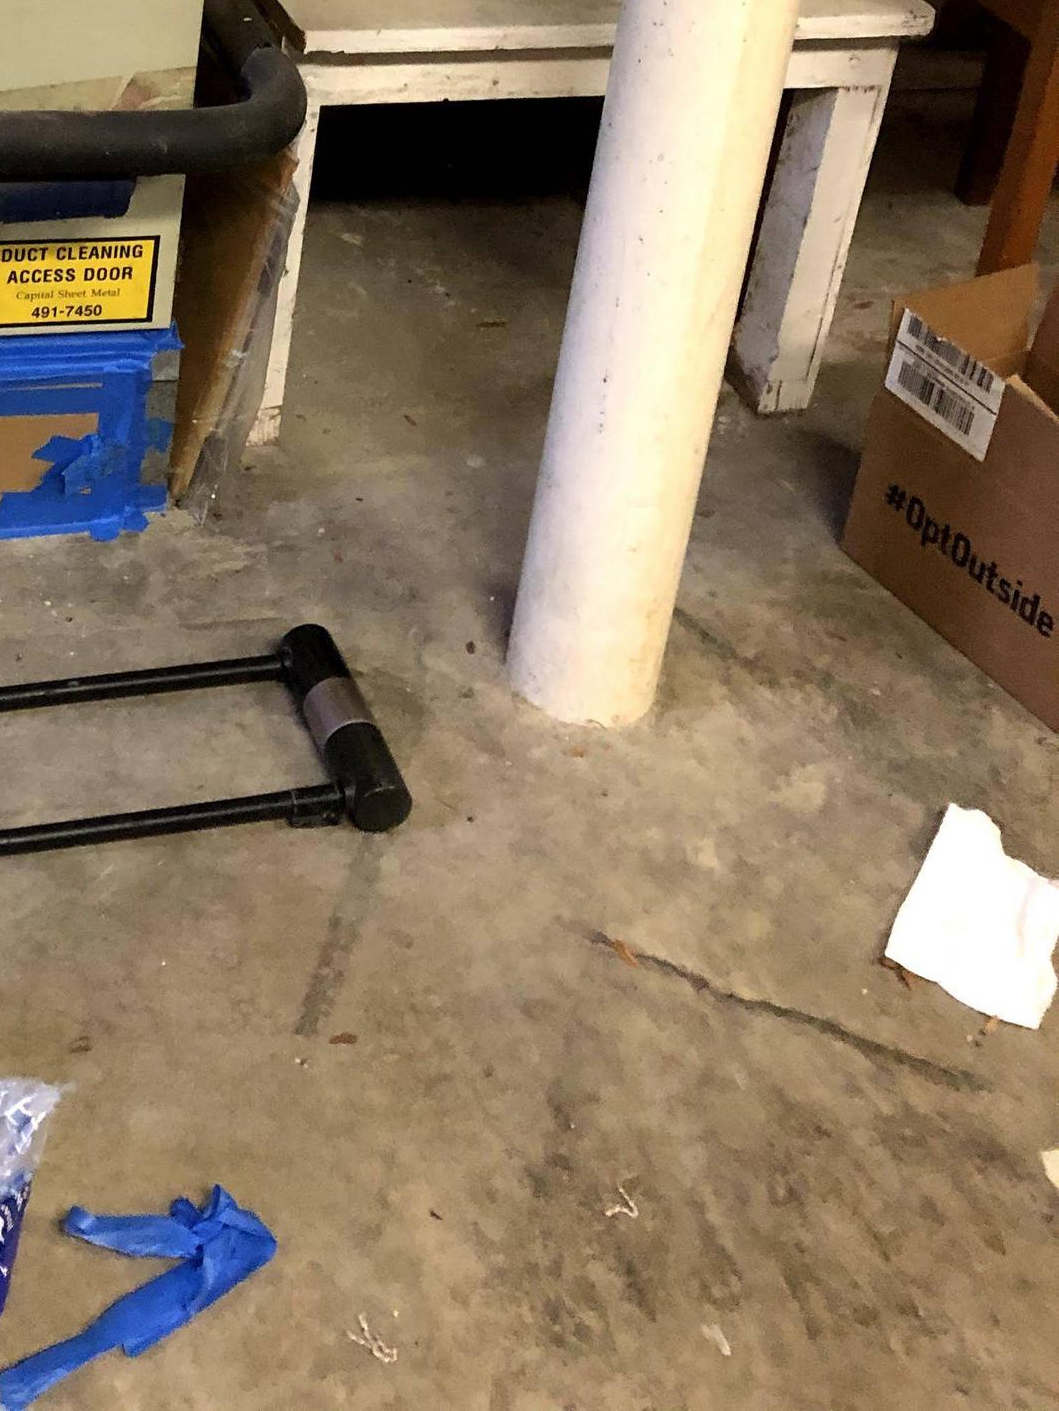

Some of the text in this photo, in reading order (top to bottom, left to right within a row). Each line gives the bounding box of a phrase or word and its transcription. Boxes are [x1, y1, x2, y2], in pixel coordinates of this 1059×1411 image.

[1, 244, 143, 262] DUCT CLEANING
[7, 266, 133, 284] ACCESS DOOR
[15, 288, 120, 302] Capital Sheet Metal
[31, 304, 102, 318] 491-7450
[885, 483, 1054, 638] #OptOutside
